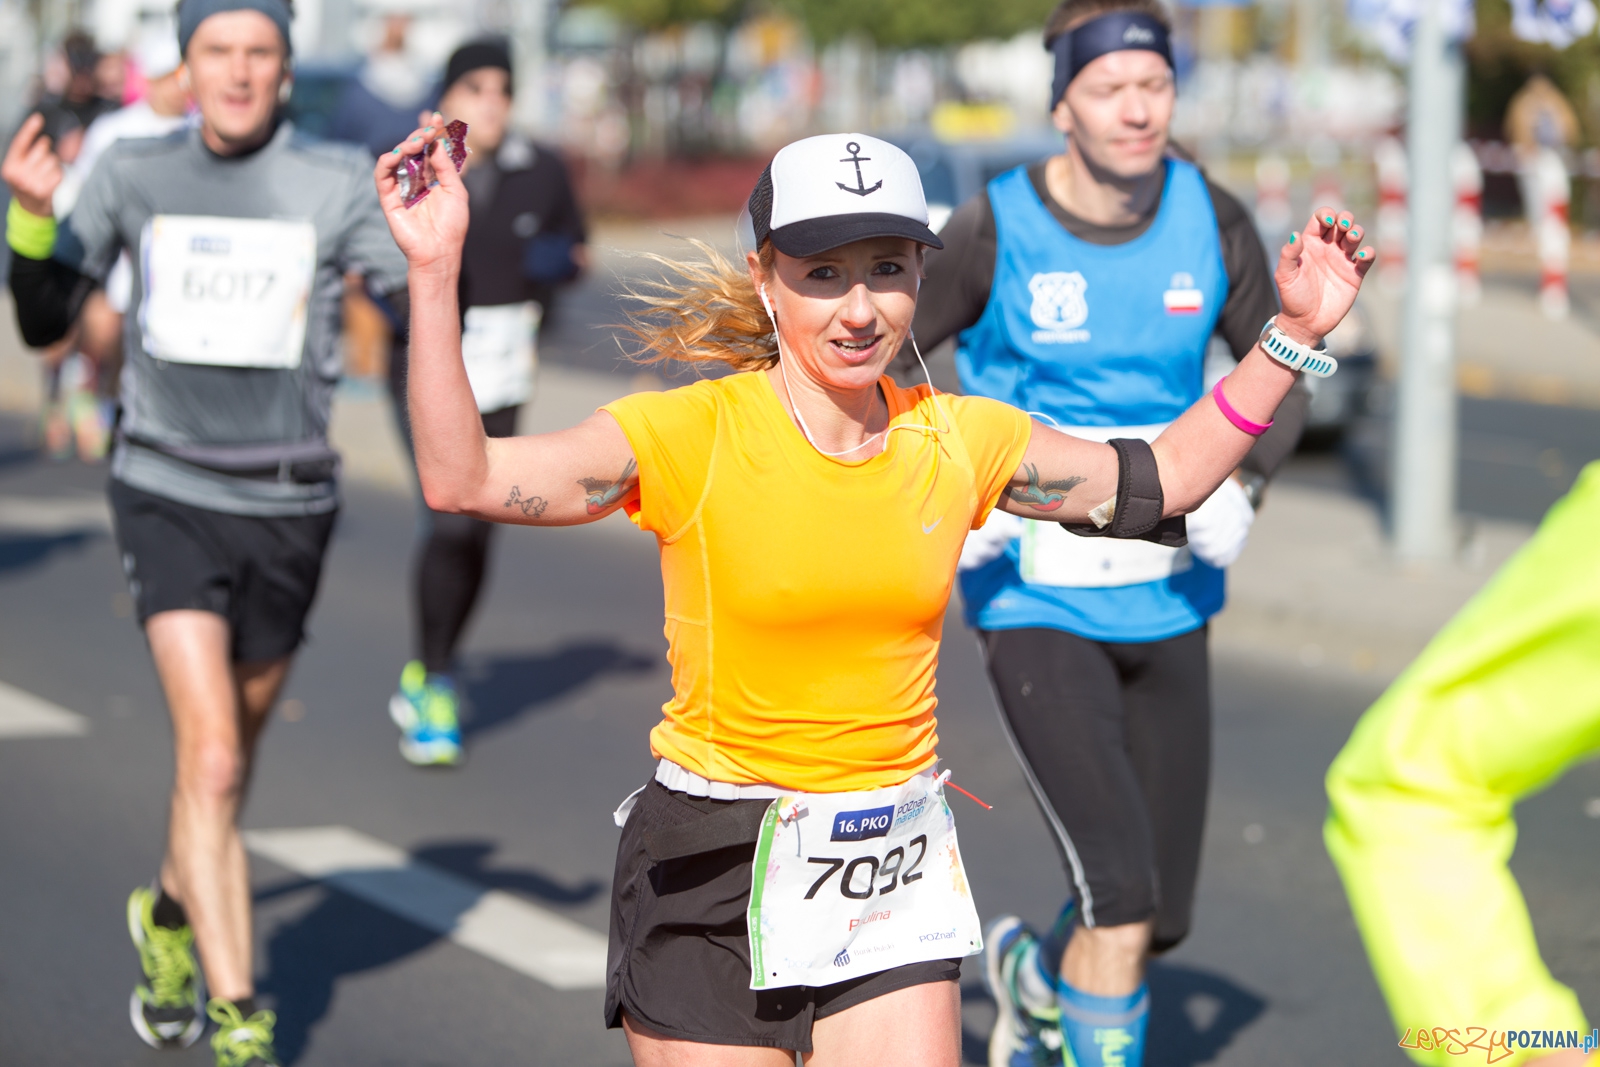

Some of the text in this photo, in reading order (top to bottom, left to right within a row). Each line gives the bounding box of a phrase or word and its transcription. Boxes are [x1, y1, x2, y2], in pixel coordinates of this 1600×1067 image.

[182, 268, 277, 302] 6017
[838, 815, 889, 834] 16. PKO
[894, 806, 925, 827] maraton
[803, 834, 928, 900] 7092
